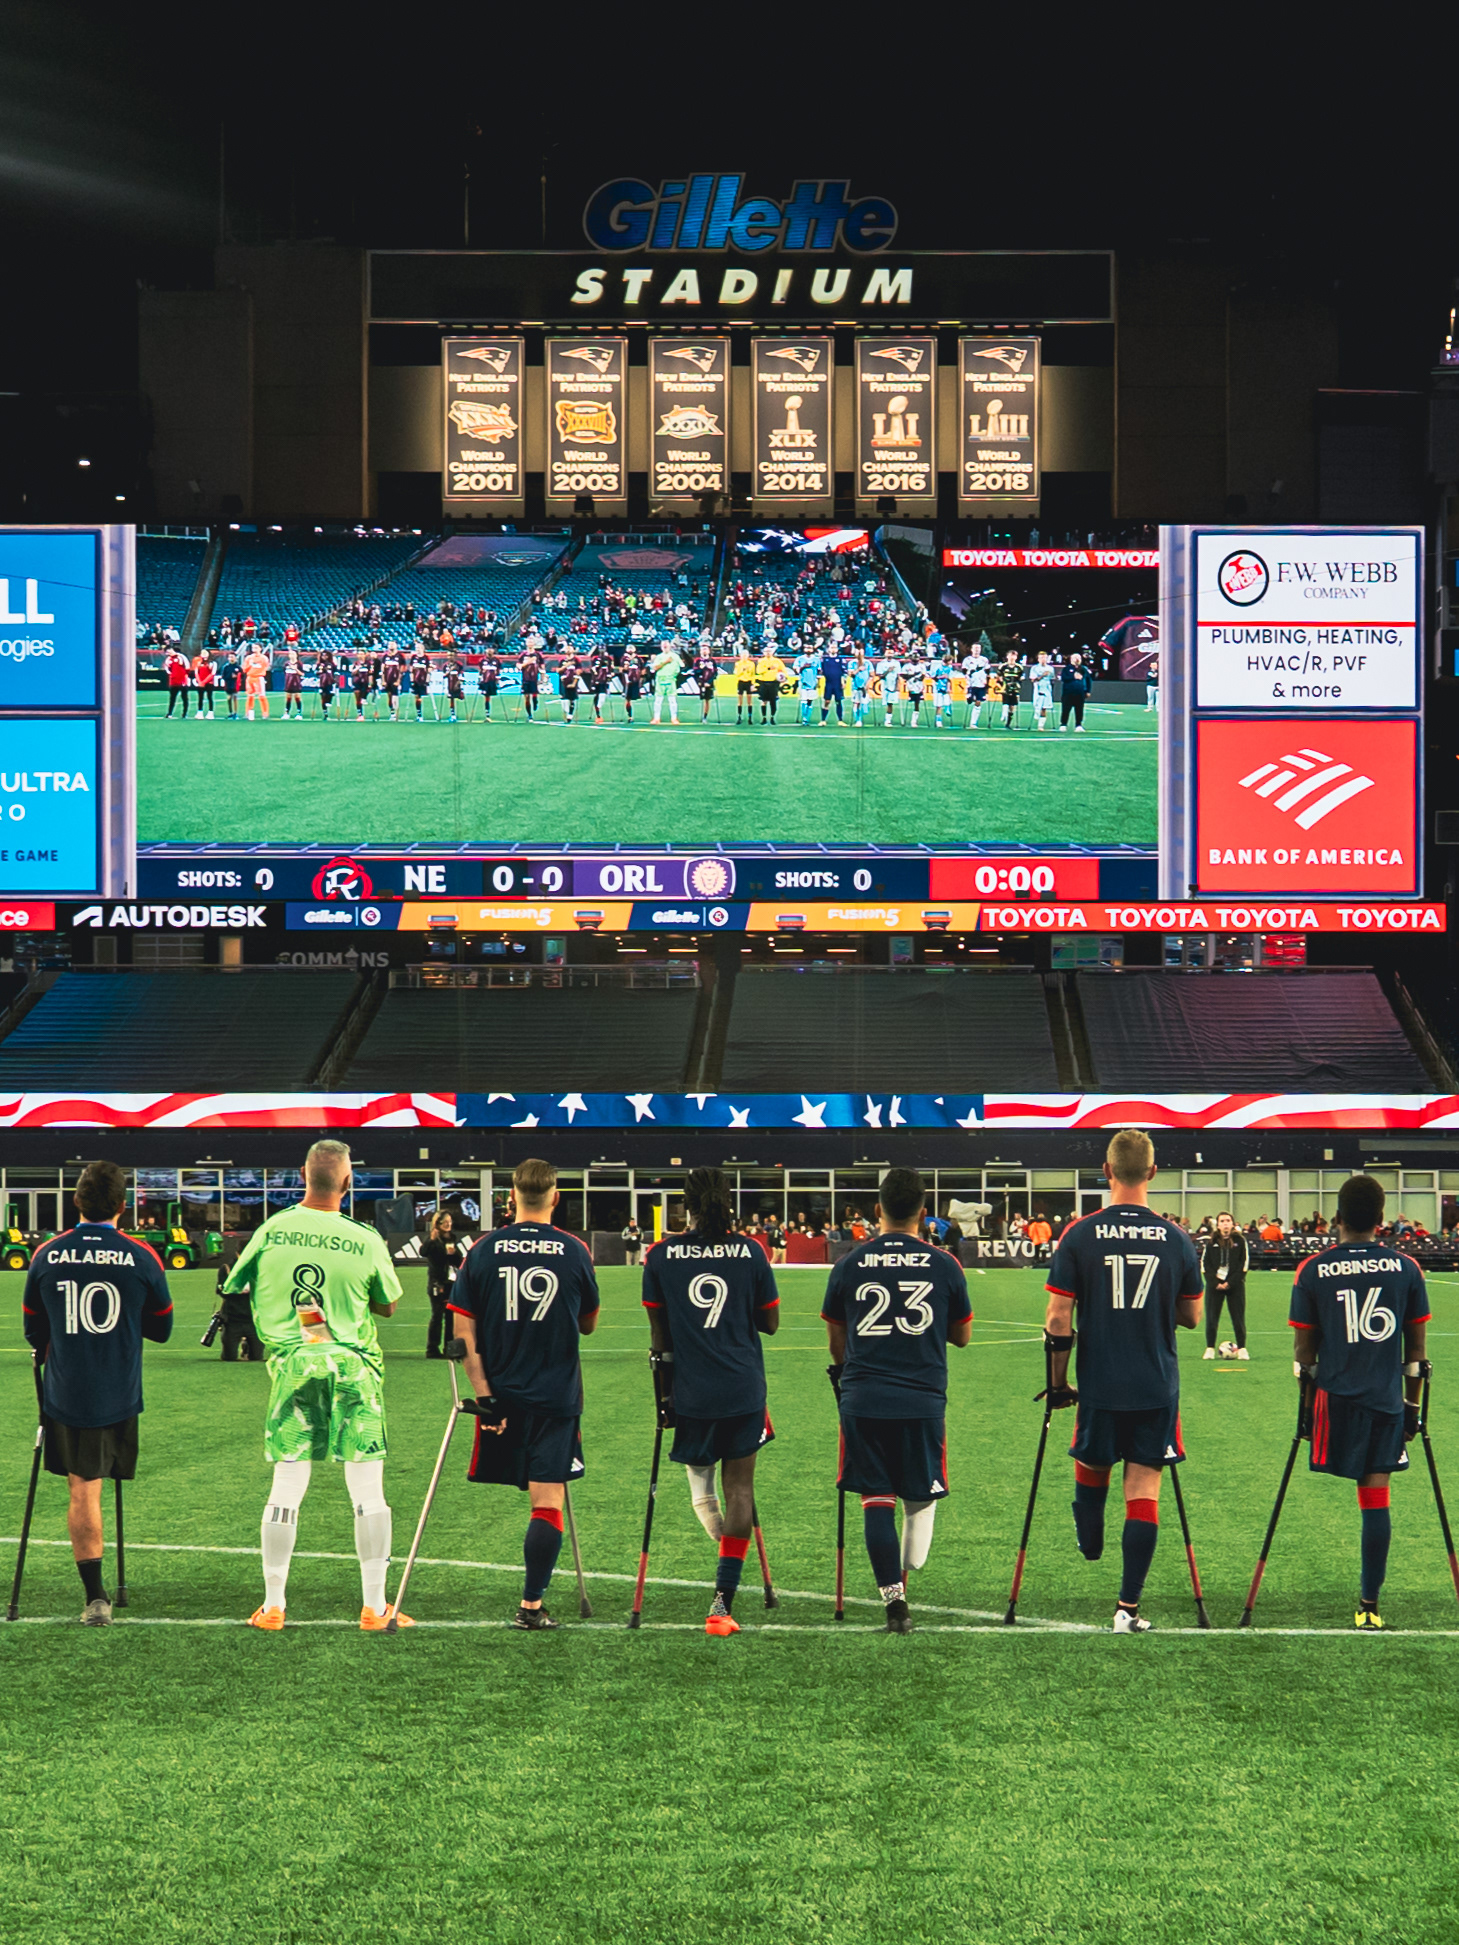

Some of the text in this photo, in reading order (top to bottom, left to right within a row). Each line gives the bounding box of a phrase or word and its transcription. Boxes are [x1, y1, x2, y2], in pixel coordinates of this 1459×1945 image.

[584, 173, 898, 253] Gillette
[571, 268, 914, 304] STADIUM
[768, 434, 817, 447] XLIX
[453, 474, 513, 491] 2001
[553, 474, 619, 491] 2003
[656, 474, 722, 491] 2004
[763, 474, 823, 491] 2014
[867, 474, 926, 491] 2016
[969, 474, 1029, 491] 2018
[951, 551, 1017, 566] TOYOTA
[1022, 551, 1090, 566] TOYOTA
[1277, 563, 1398, 582] F.W. WEBB
[1304, 588, 1368, 599] COMPANY
[1212, 629, 1403, 646] PLUMBING, HEATING,
[1247, 651, 1367, 674] HVAC/R, PVF
[1272, 682, 1342, 697] & more
[1, 772, 90, 792] ULTRA
[15, 850, 58, 861] GAME
[1209, 849, 1403, 865] BANK OF AMERICA
[177, 871, 242, 888] SHOTS:
[404, 865, 447, 893] NE
[492, 866, 514, 892] 0
[541, 866, 563, 892] 0
[599, 865, 663, 893] ORL
[775, 869, 872, 891] SHOTS: 0
[975, 865, 1055, 893] 0:00
[108, 906, 267, 928] AUTODESK
[984, 908, 1440, 928] TOYOTA TOYOTA TOYOTA TOYOTA
[1095, 1224, 1167, 1241] HAMMER
[266, 1231, 365, 1256] HENRICKSON
[494, 1240, 564, 1255] FISCHER
[666, 1244, 752, 1259] MUSABWA
[47, 1249, 135, 1267] CALABRIA
[858, 1253, 931, 1267] JIMENEZ
[1318, 1258, 1402, 1278] ROBINSON
[291, 1263, 325, 1309] 8
[1104, 1254, 1160, 1309] 17
[498, 1266, 558, 1321] 19
[688, 1273, 728, 1328] 9
[56, 1280, 121, 1334] 10
[855, 1281, 934, 1336] 23
[1336, 1287, 1397, 1343] 16
